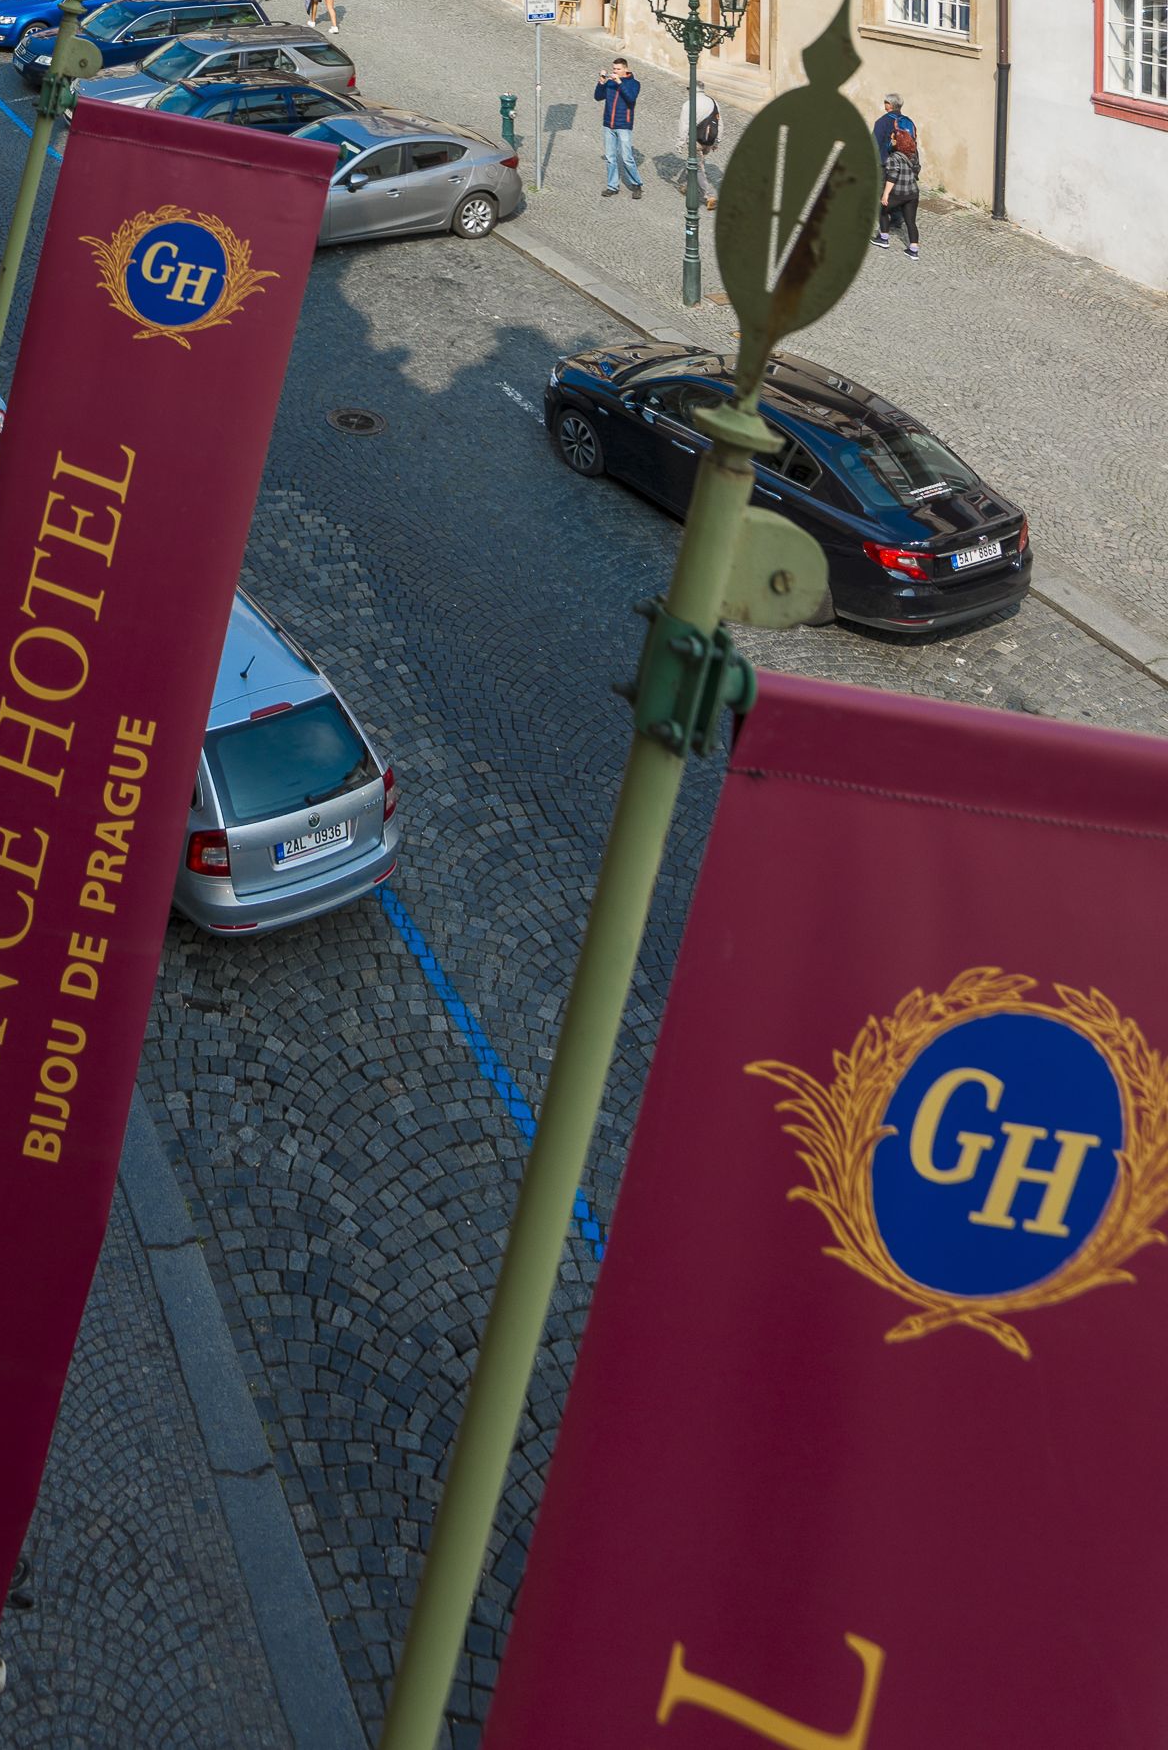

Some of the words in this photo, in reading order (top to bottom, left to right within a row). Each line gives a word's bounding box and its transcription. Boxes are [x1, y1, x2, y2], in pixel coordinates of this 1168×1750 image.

[141, 242, 217, 306] GH
[978, 543, 998, 559] 8868
[79, 715, 157, 914] PRAGUE
[285, 838, 307, 855] 2AL
[314, 823, 342, 845] 0936
[59, 932, 108, 1000] DE
[22, 1019, 87, 1163] BIJOU
[910, 1068, 1101, 1238] GH
